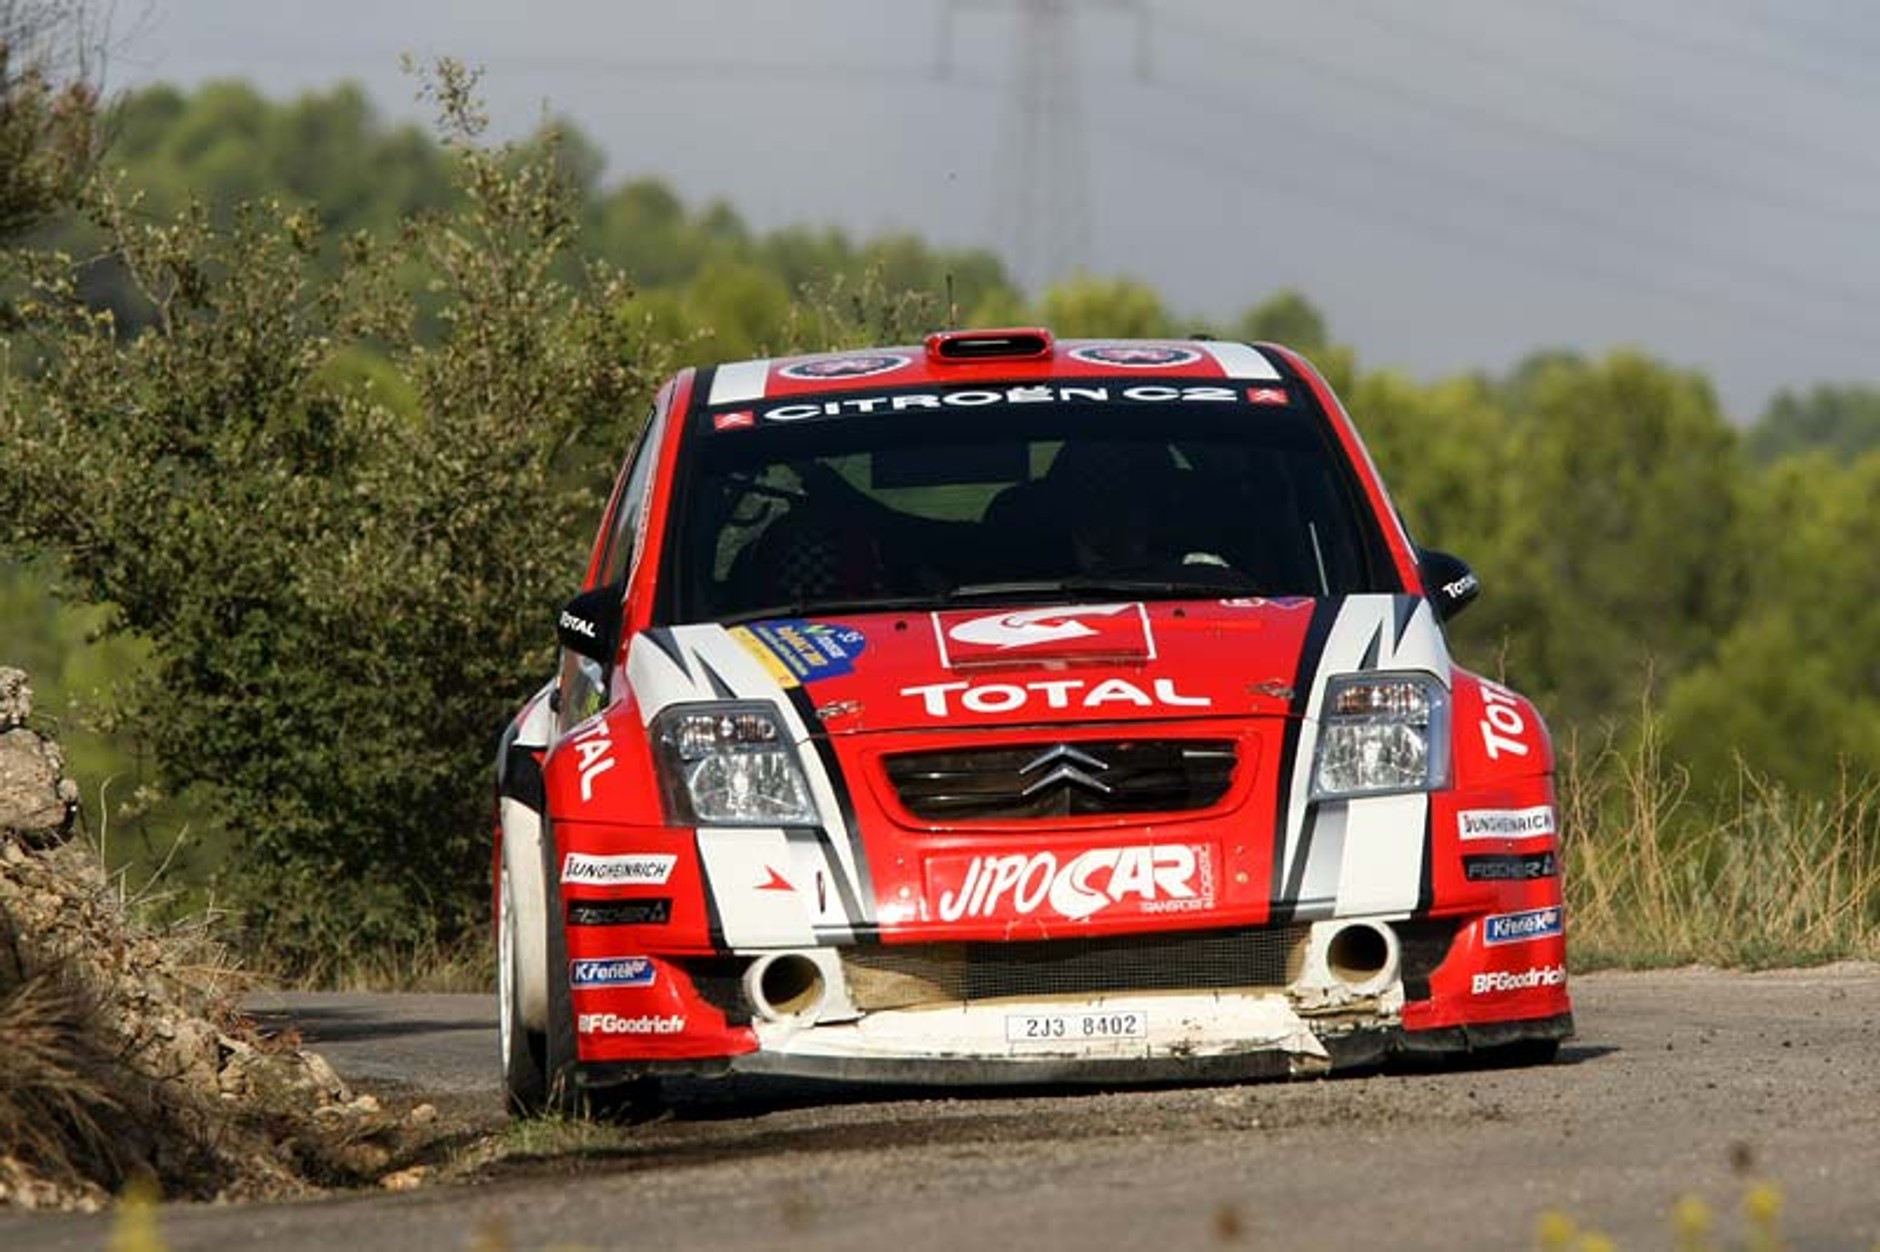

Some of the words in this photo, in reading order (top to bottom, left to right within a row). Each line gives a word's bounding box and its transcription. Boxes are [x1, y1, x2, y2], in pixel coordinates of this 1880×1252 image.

[764, 385, 1108, 420] CITROËN
[1123, 387, 1238, 400] C2
[901, 679, 1212, 717] TOTAL
[1026, 1019, 1065, 1037] 2J3
[1083, 1015, 1136, 1034] 8402
